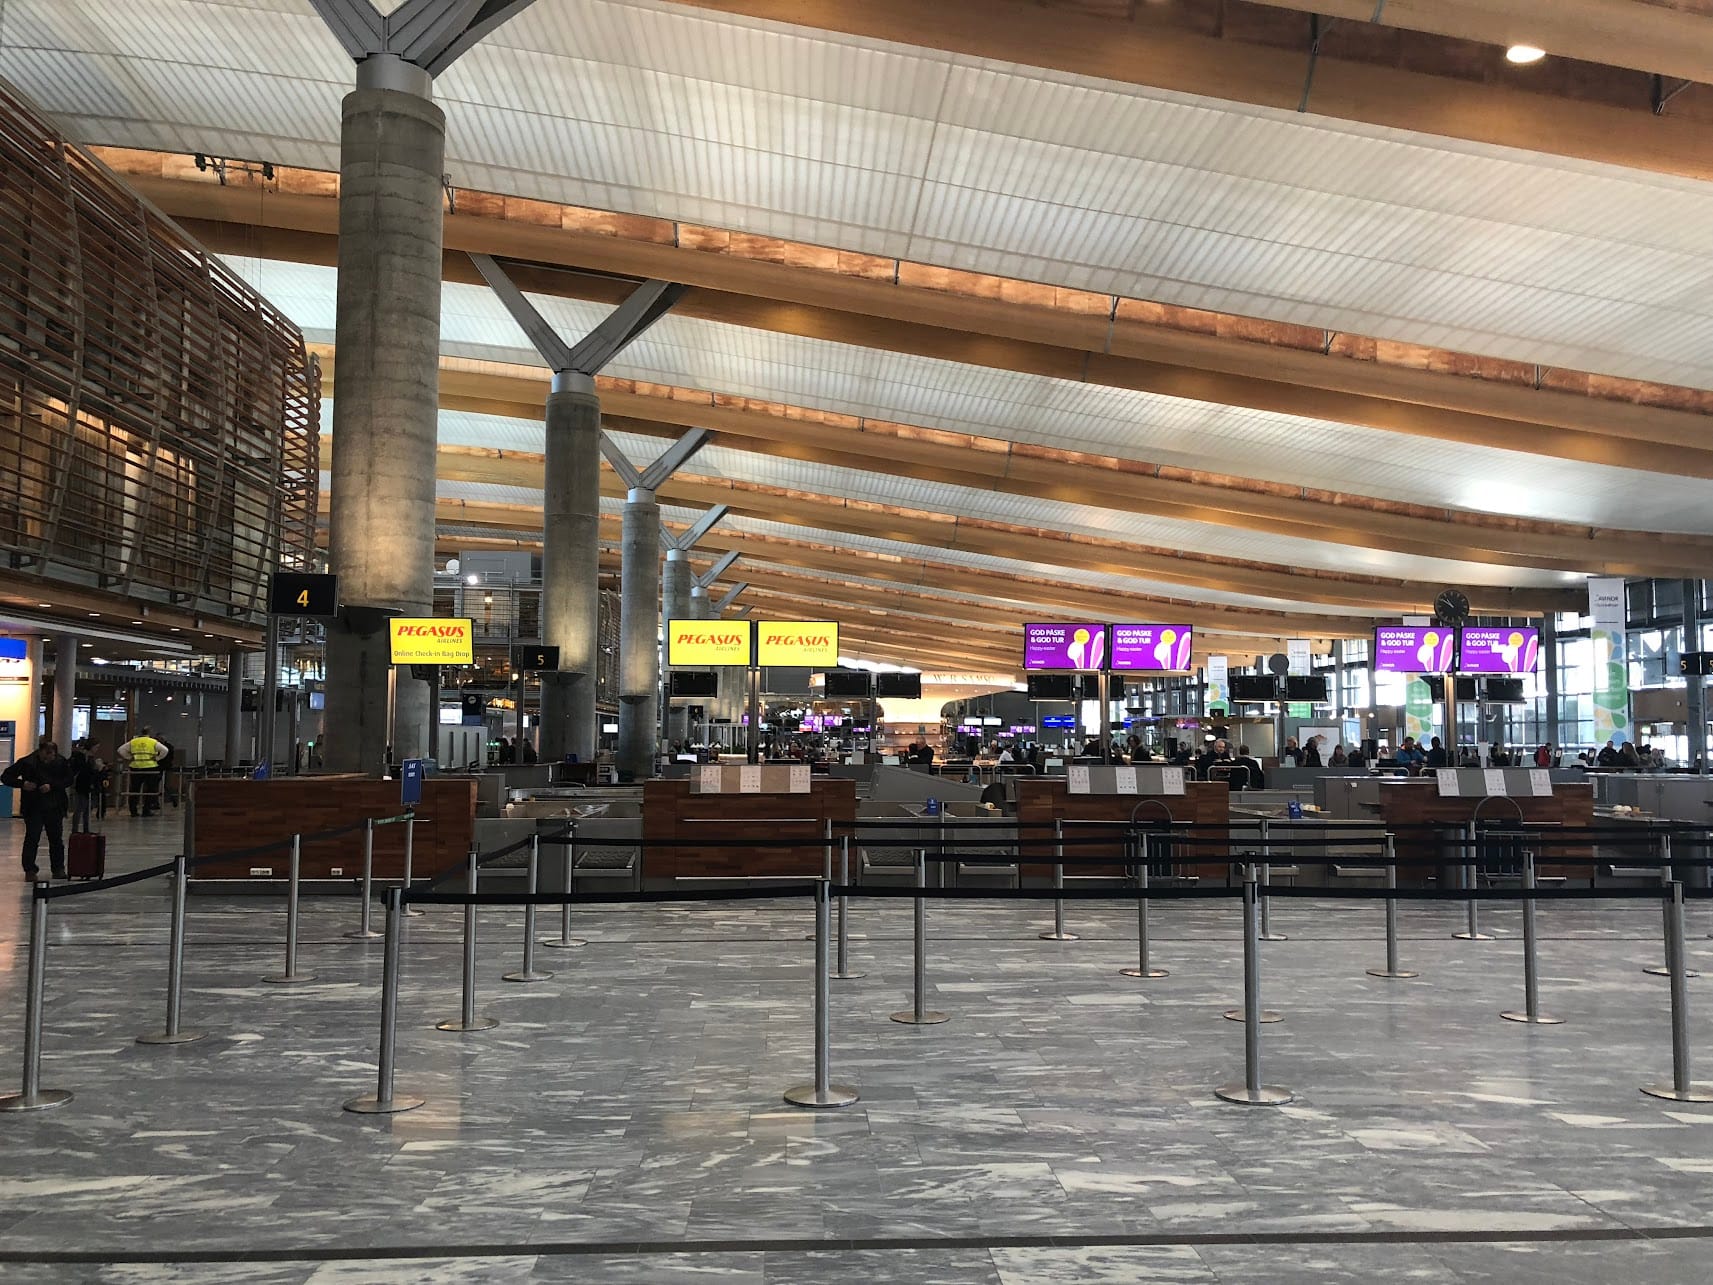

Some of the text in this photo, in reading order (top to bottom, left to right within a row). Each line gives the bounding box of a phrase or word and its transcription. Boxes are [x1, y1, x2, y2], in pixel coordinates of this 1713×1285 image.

[297, 590, 309, 607] 4
[397, 625, 465, 637] PEGASUS
[677, 634, 743, 645] PEGASUS
[766, 635, 831, 647] PEGASUS
[394, 649, 414, 657] Online
[441, 651, 454, 659] Bag
[537, 654, 545, 665] 5
[1680, 660, 1688, 671] 5
